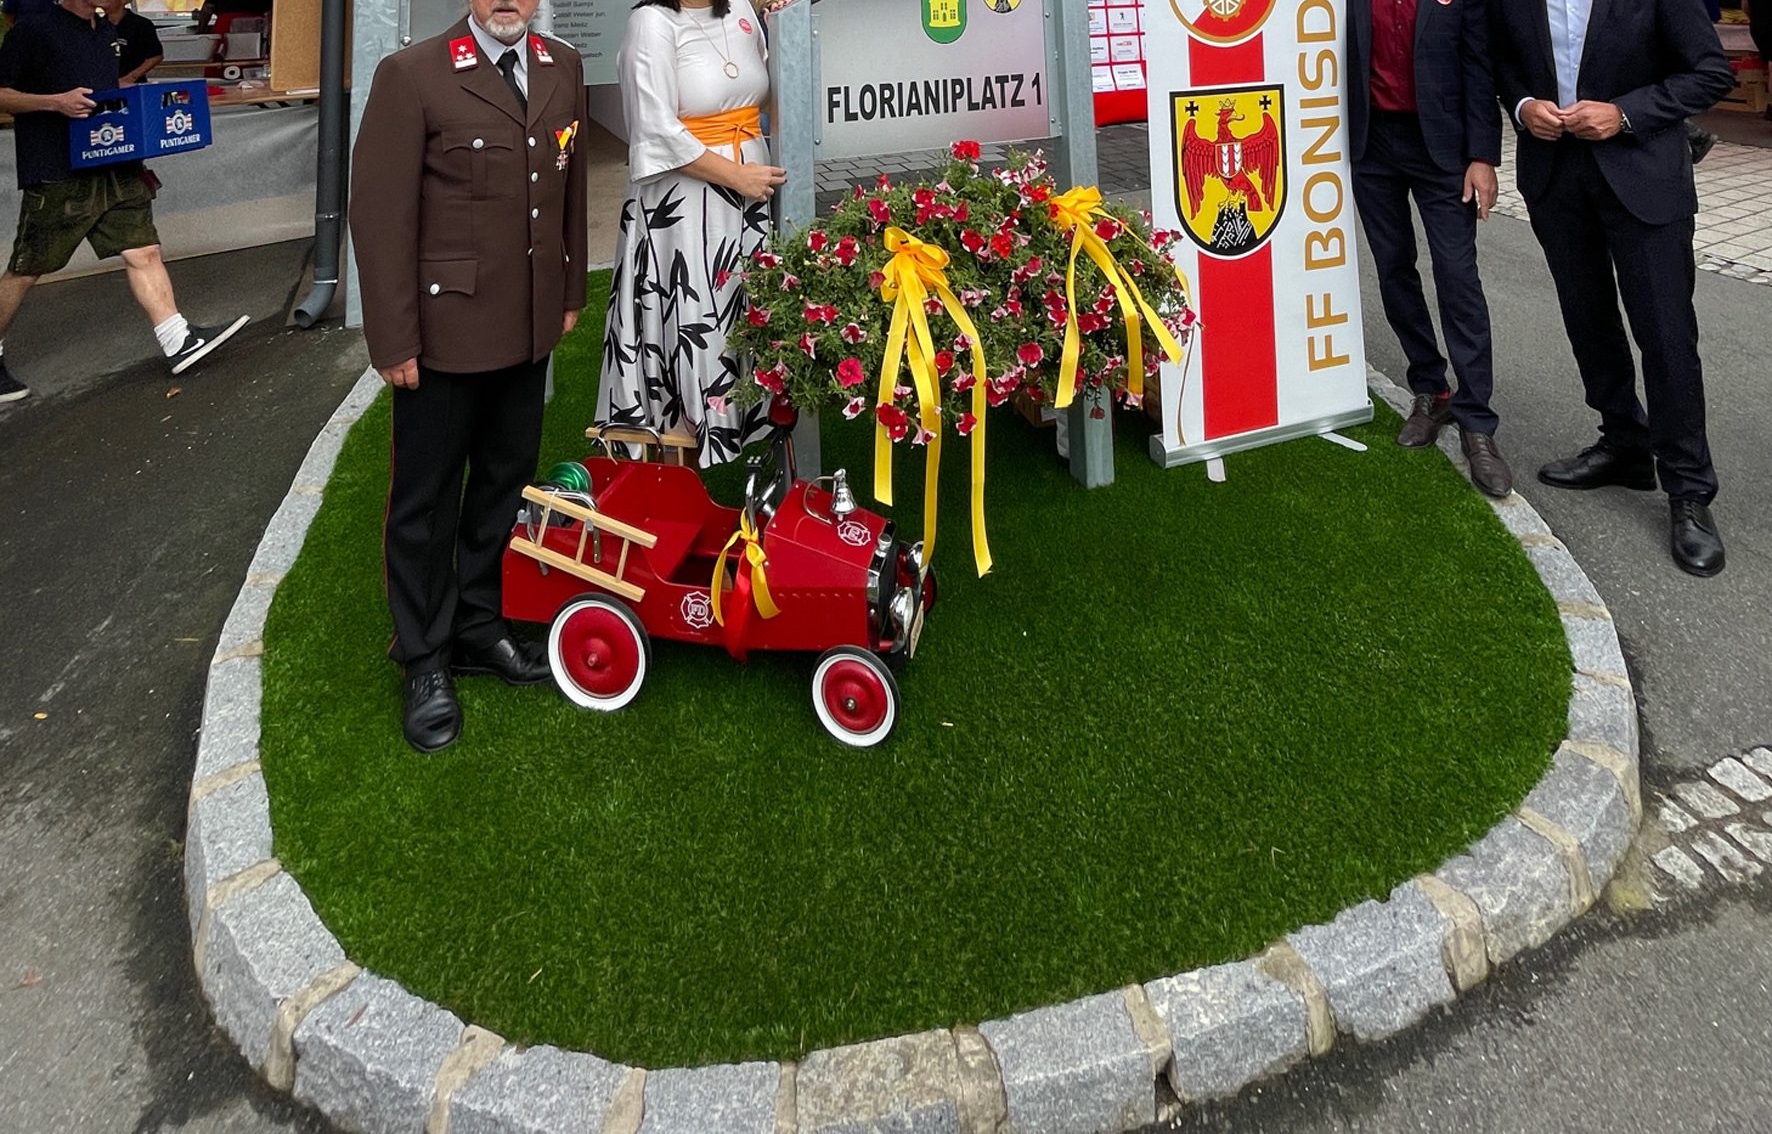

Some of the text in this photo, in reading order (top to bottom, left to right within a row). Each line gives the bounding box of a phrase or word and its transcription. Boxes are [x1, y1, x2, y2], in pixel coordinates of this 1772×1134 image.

[827, 72, 1042, 123] FLORIANIPLATZ 1
[82, 144, 135, 160] PUNTIGAMER
[161, 133, 200, 149] PUNTIGAMER
[1306, 292, 1350, 372] FF
